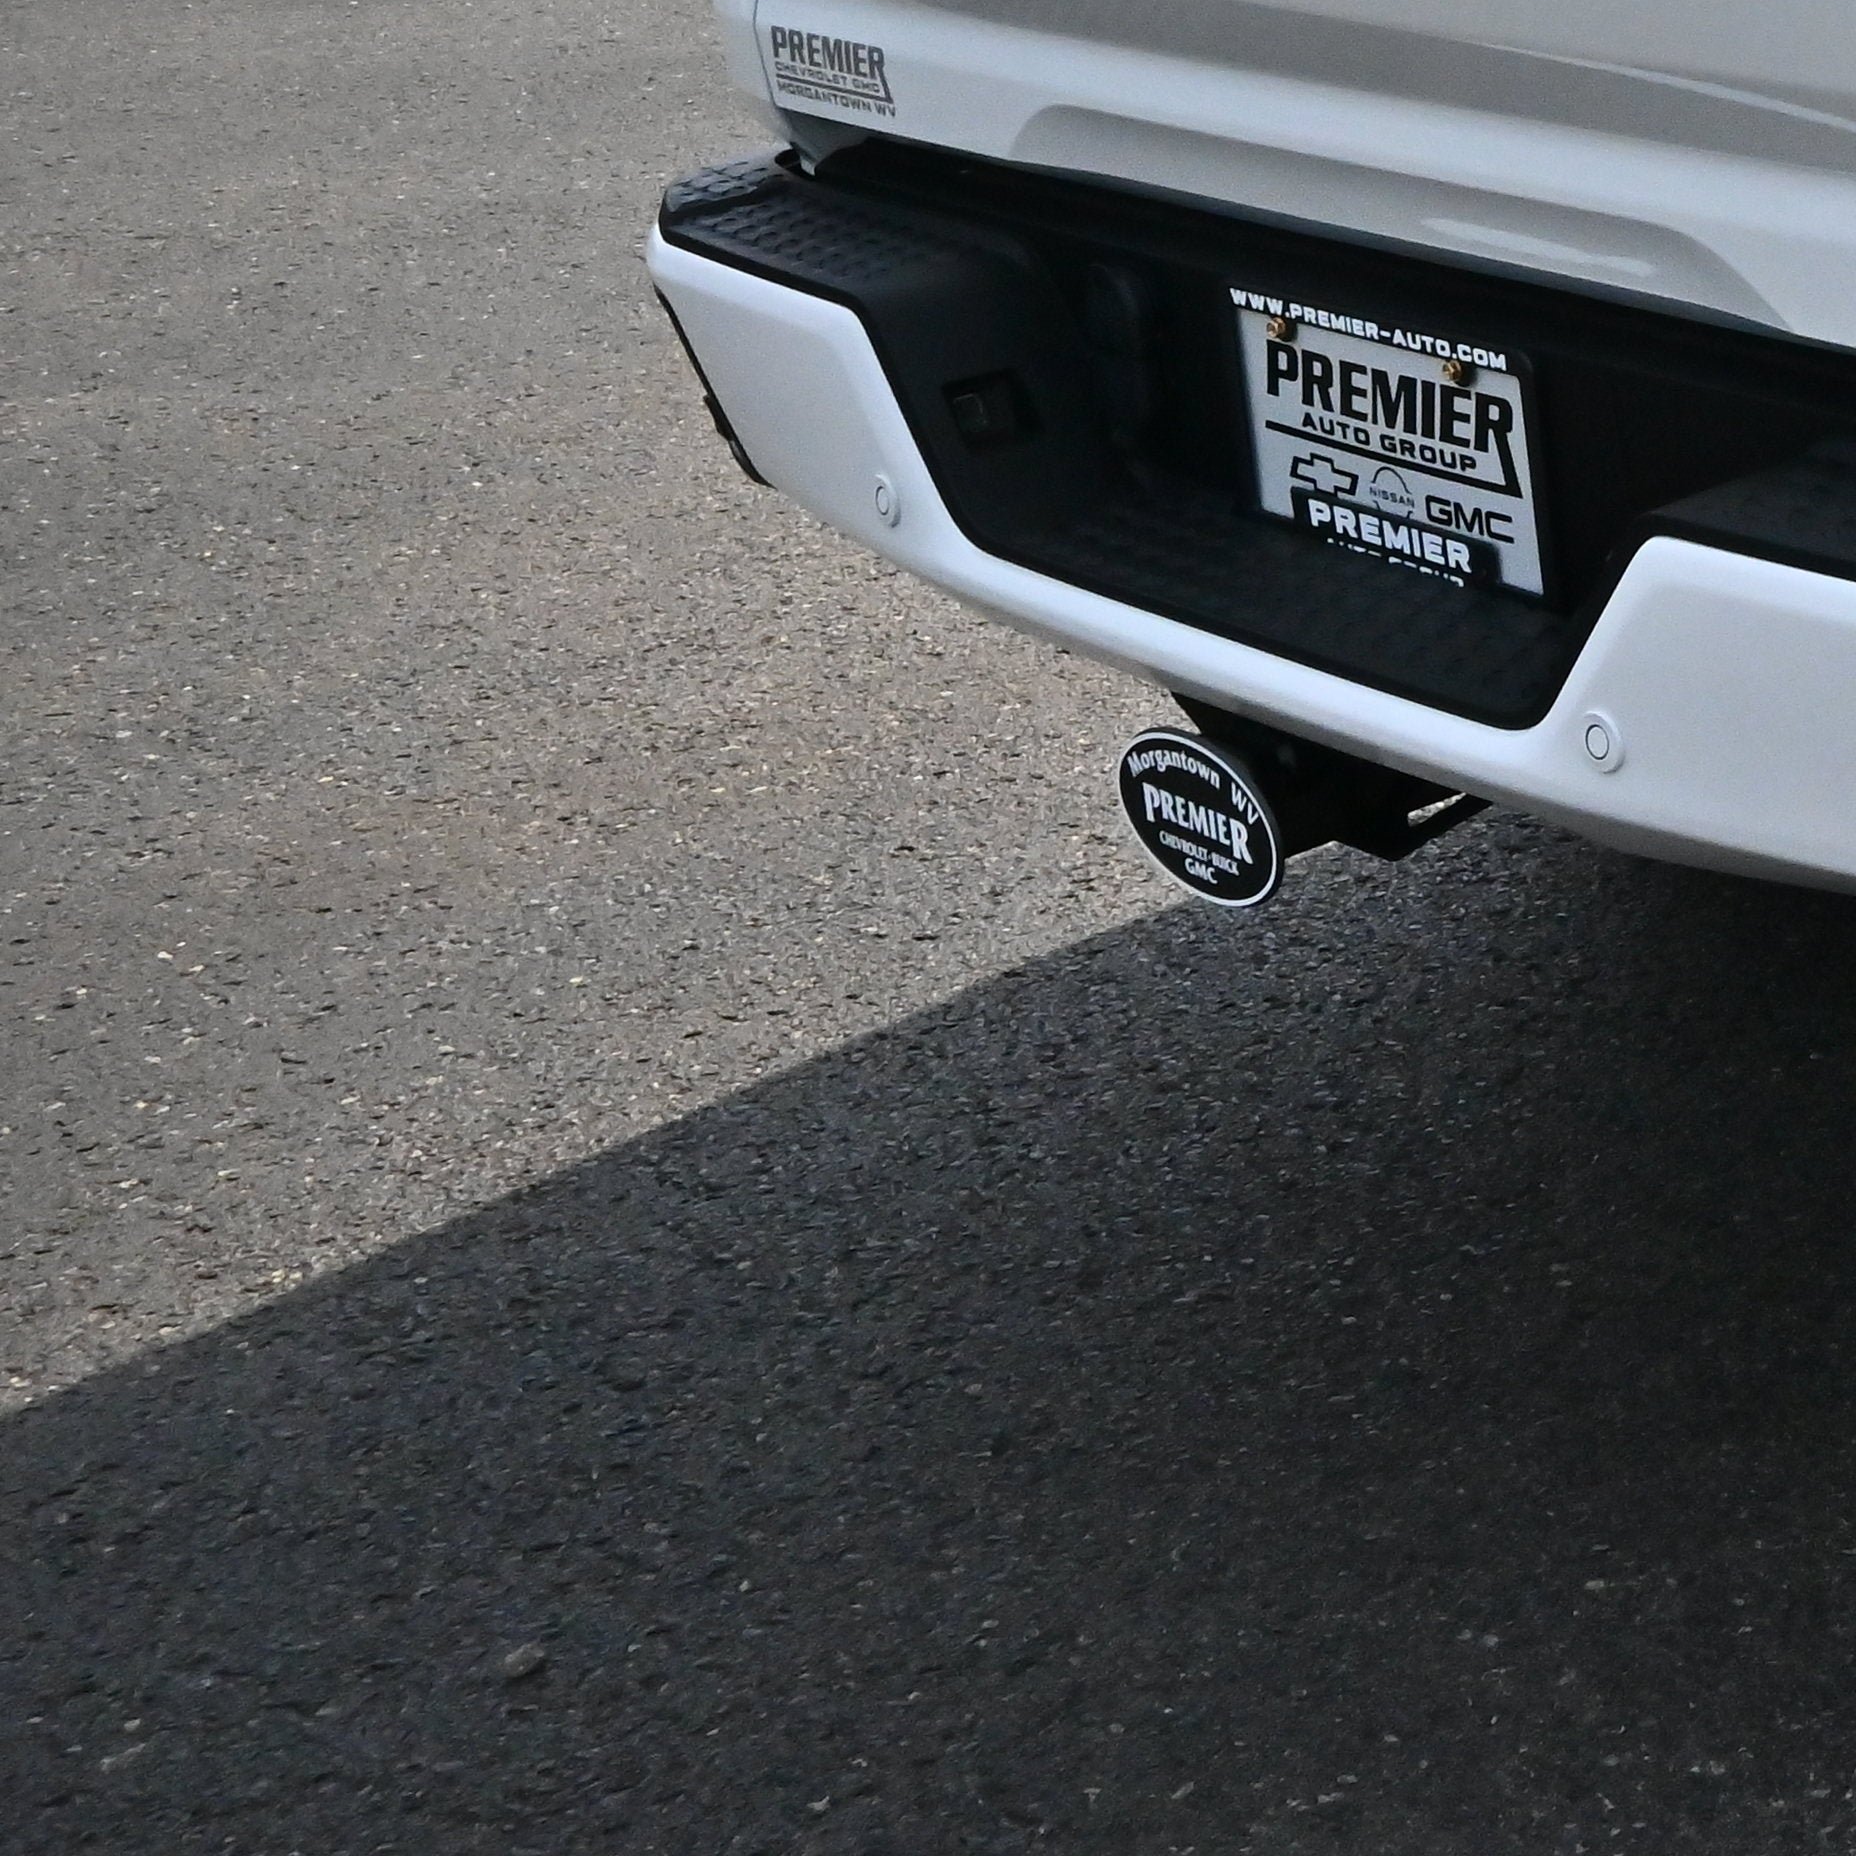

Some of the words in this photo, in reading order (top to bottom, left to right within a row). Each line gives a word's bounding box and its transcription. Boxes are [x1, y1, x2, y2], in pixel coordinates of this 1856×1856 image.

[771, 25, 886, 81] PREMIER
[774, 60, 848, 87] CHEVROLET
[776, 79, 872, 113] MORGANTOWN
[874, 104, 897, 118] WV
[1230, 287, 1507, 372] WWW.PREMIER-AUTO.COM
[1266, 338, 1514, 454] PREMIER
[1302, 411, 1371, 447] AUTO
[1379, 433, 1477, 473] GROUP
[1369, 486, 1415, 509] NISSAN
[1425, 494, 1515, 544] GMC
[1307, 498, 1473, 574] PREMIER
[1126, 748, 1221, 790] Morgantown
[1230, 781, 1261, 826] WV
[1142, 781, 1254, 865] PREMIER
[1159, 830, 1209, 862] CHEVROLET
[1184, 857, 1219, 885] GMC
